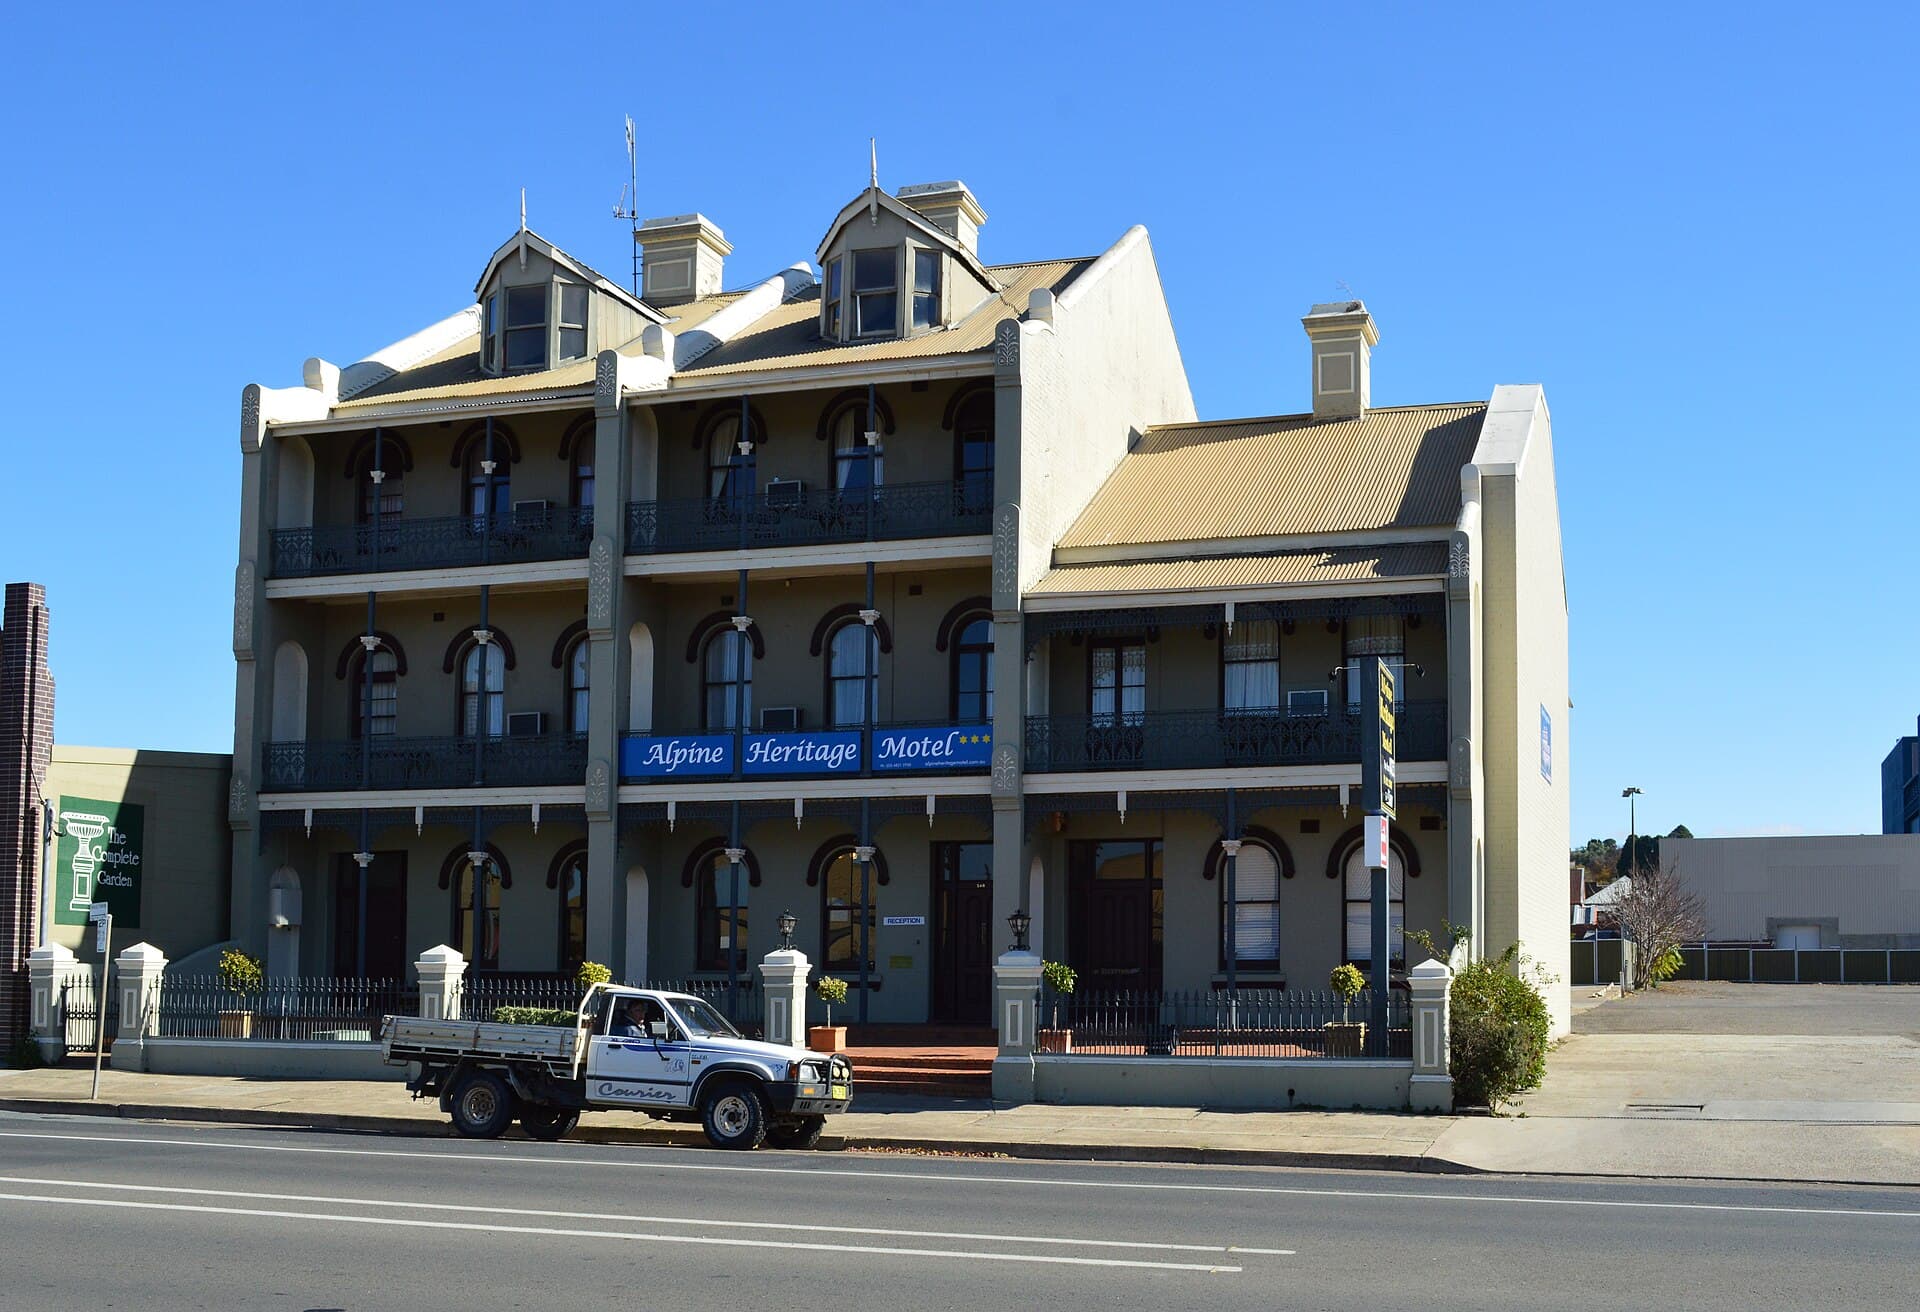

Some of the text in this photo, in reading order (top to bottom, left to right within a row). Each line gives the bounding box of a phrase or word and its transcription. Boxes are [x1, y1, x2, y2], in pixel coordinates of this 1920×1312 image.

[642, 731, 960, 772] Alpine Heritage Motel
[108, 826, 127, 845] The
[92, 845, 140, 869] Complete
[97, 870, 133, 888] Garden
[598, 1083, 676, 1100] Courier
